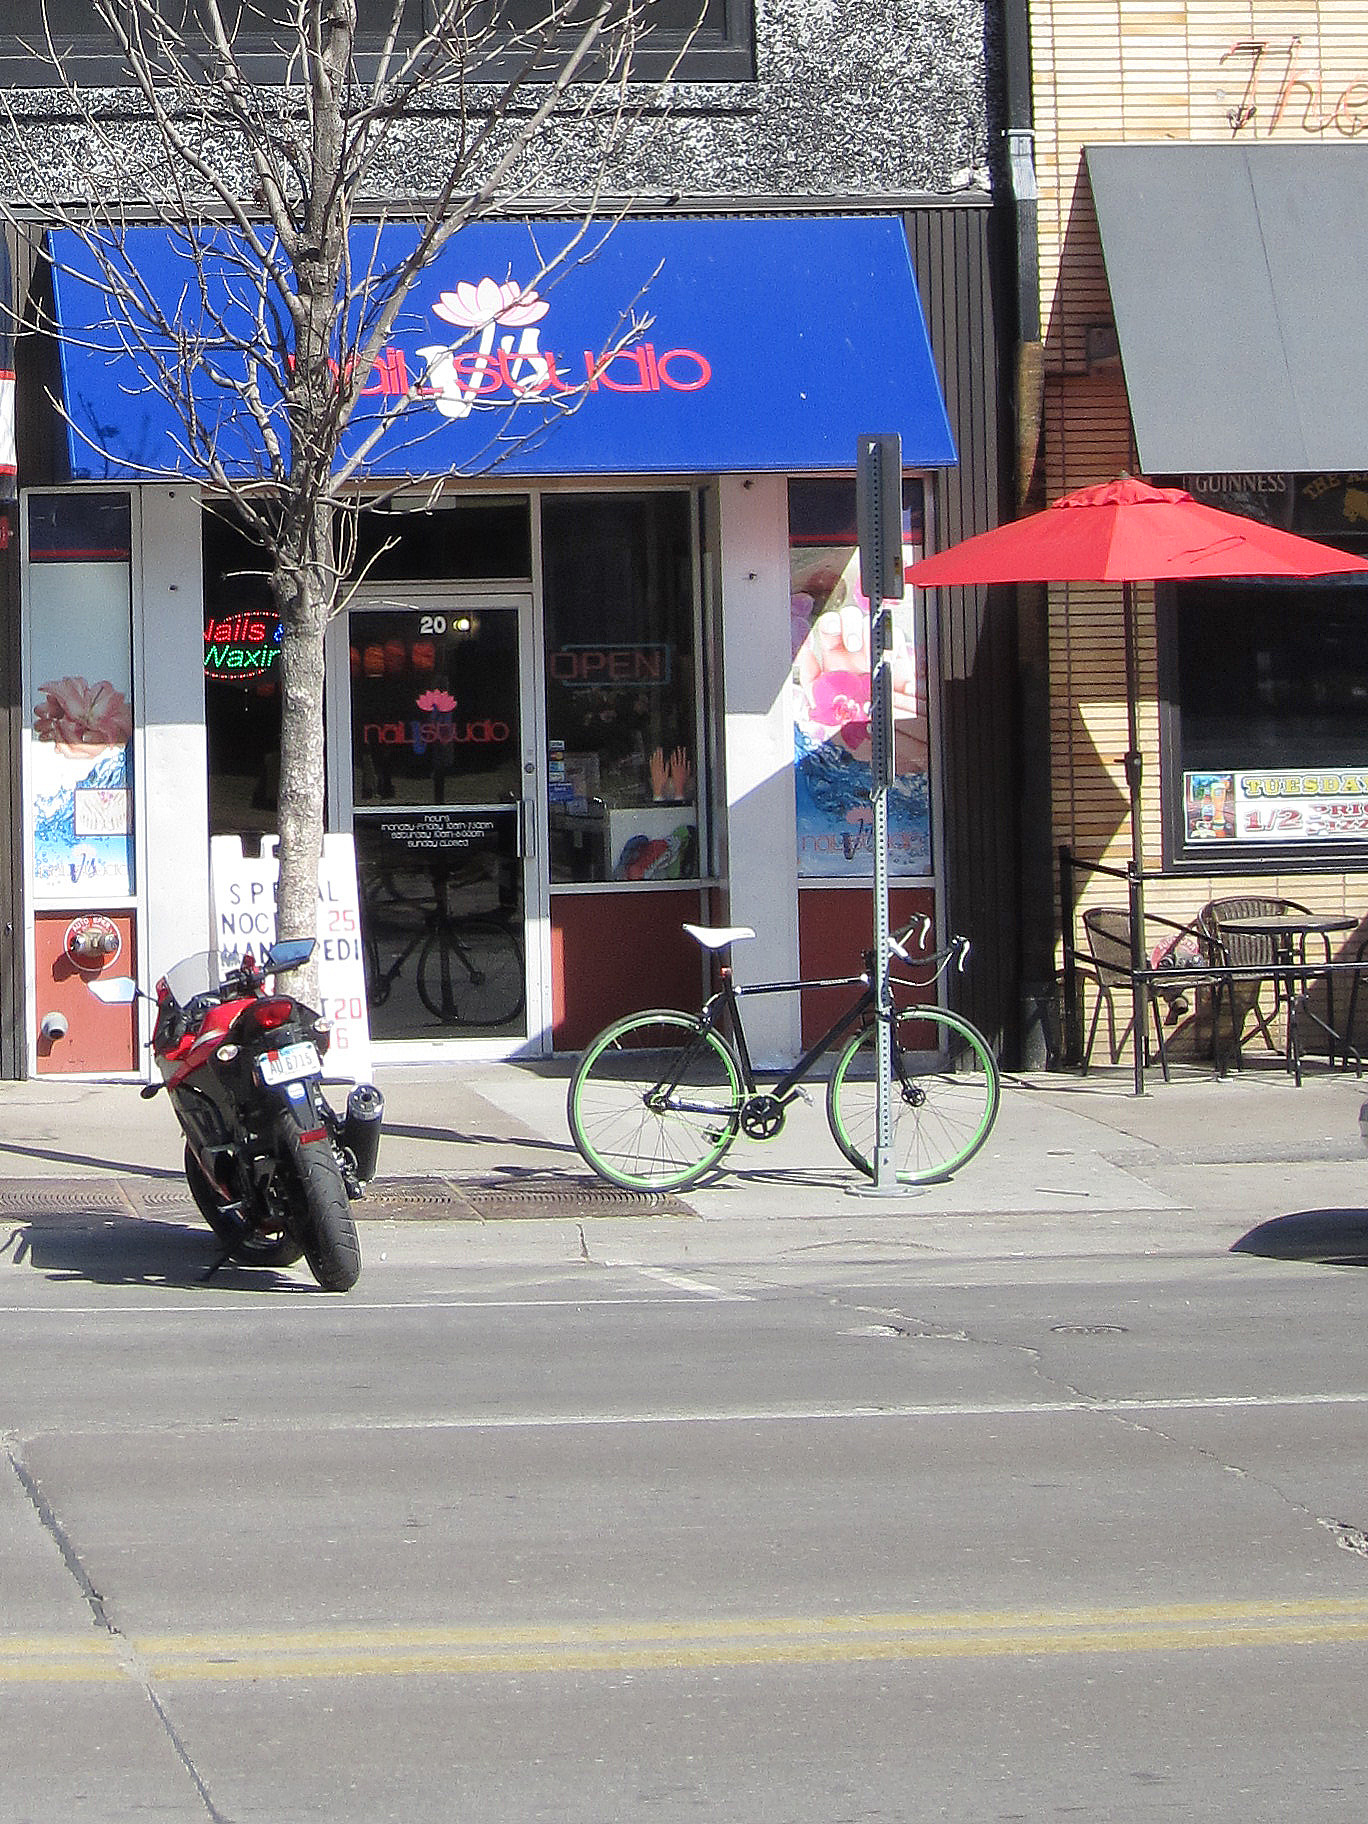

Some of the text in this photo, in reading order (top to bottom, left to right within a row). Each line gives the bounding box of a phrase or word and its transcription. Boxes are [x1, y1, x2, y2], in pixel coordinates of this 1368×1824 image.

[453, 344, 712, 392] studio
[1195, 474, 1287, 493] GUINNESS
[419, 616, 447, 634] 20
[551, 652, 661, 680] OPEN
[1244, 806, 1304, 832] 1/2
[329, 909, 356, 932] 25
[334, 997, 362, 1021] 20
